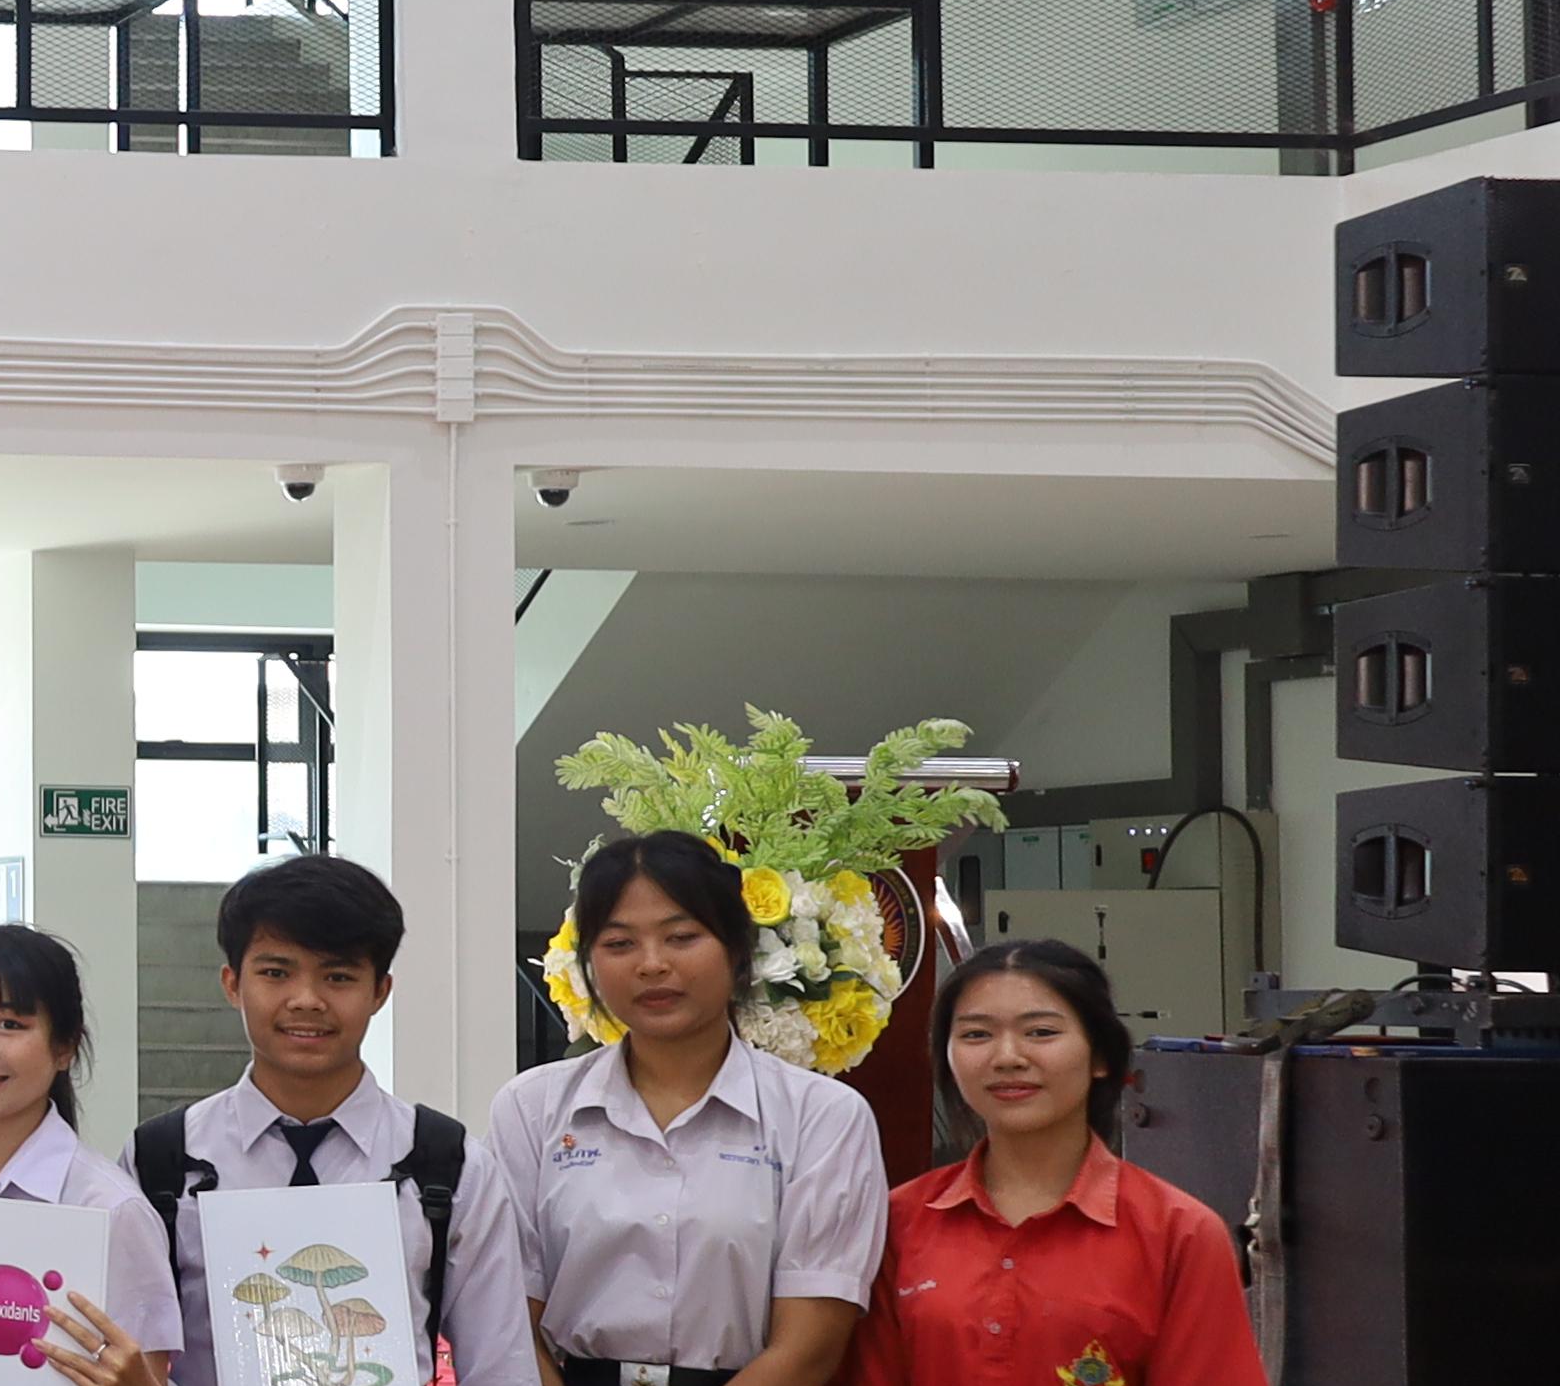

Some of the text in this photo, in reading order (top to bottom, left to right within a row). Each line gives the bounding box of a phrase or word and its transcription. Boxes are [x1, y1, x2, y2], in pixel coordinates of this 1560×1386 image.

[91, 797, 126, 814] FIRE
[91, 814, 126, 832] EXIT
[10, 870, 17, 898] 1
